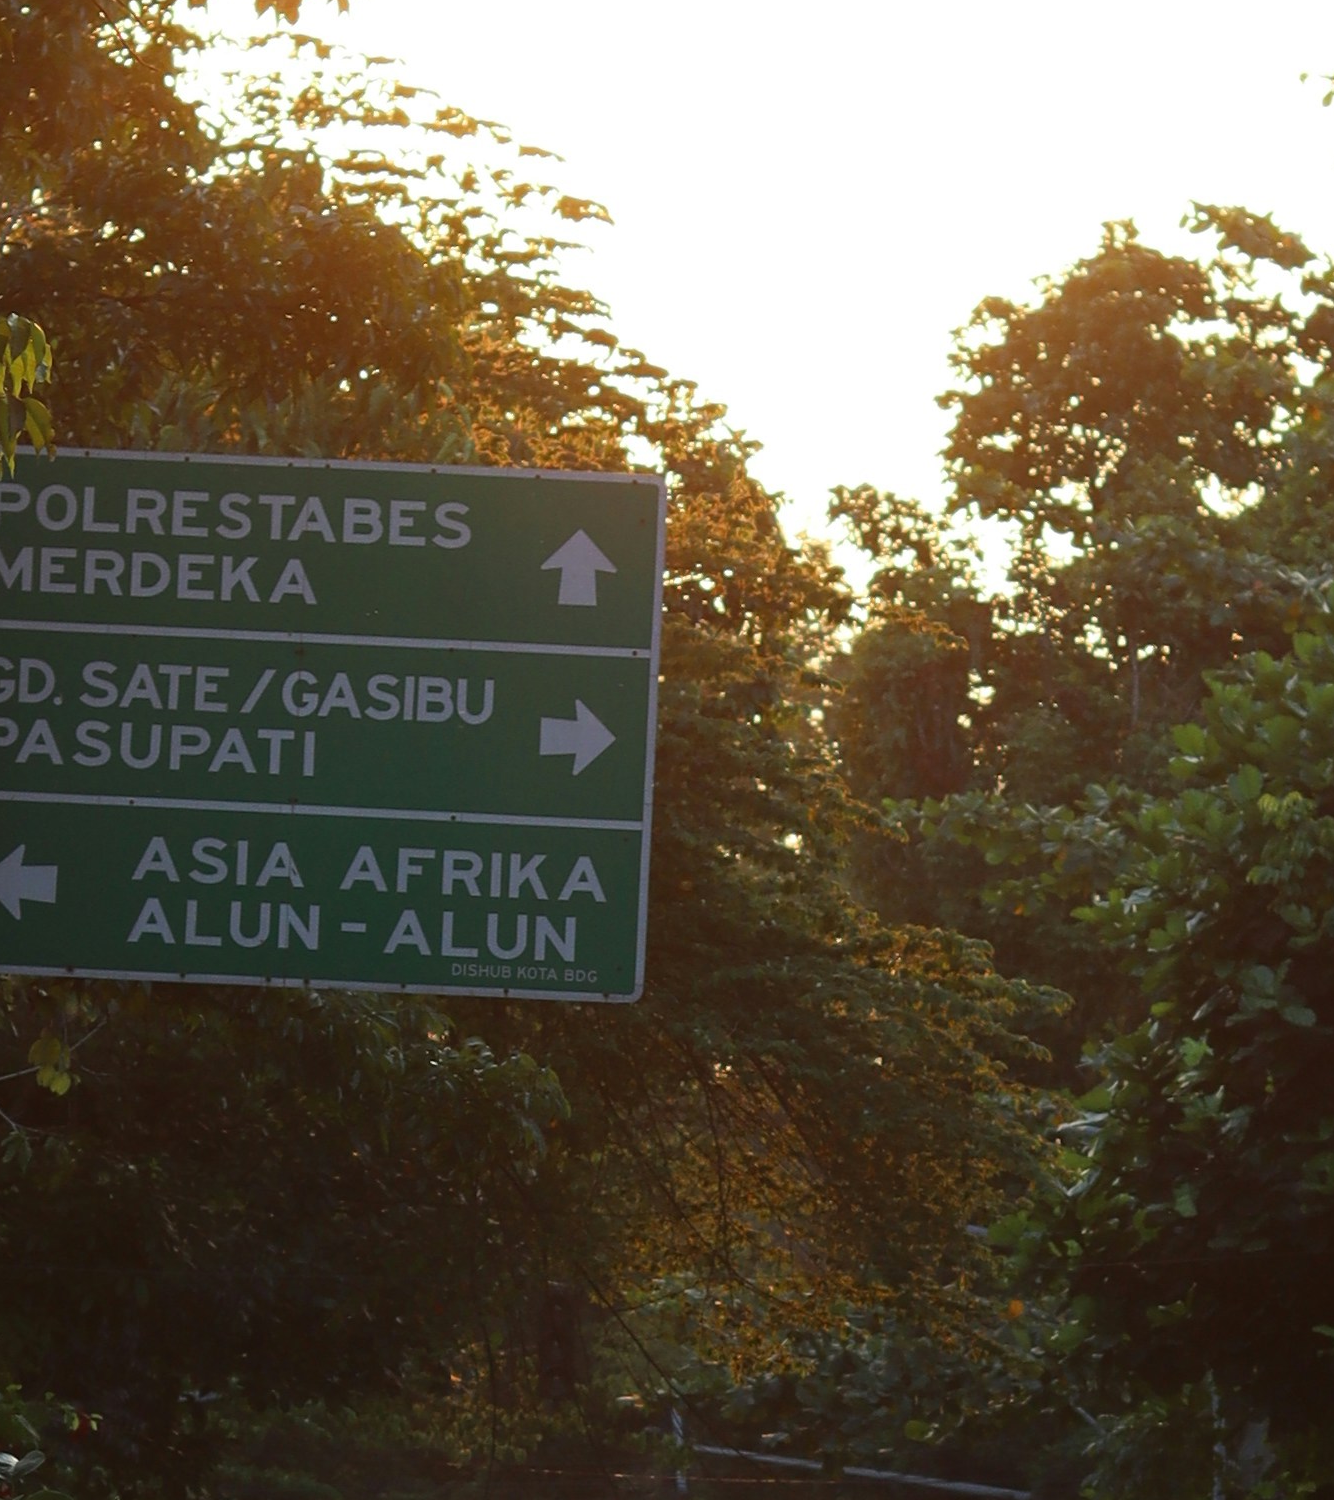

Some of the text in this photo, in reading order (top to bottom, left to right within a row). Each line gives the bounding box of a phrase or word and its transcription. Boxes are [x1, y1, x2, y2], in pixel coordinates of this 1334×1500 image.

[130, 836, 608, 903] ASIA AFRIKA
[451, 962, 599, 983] DISHUB KOTA BDG
